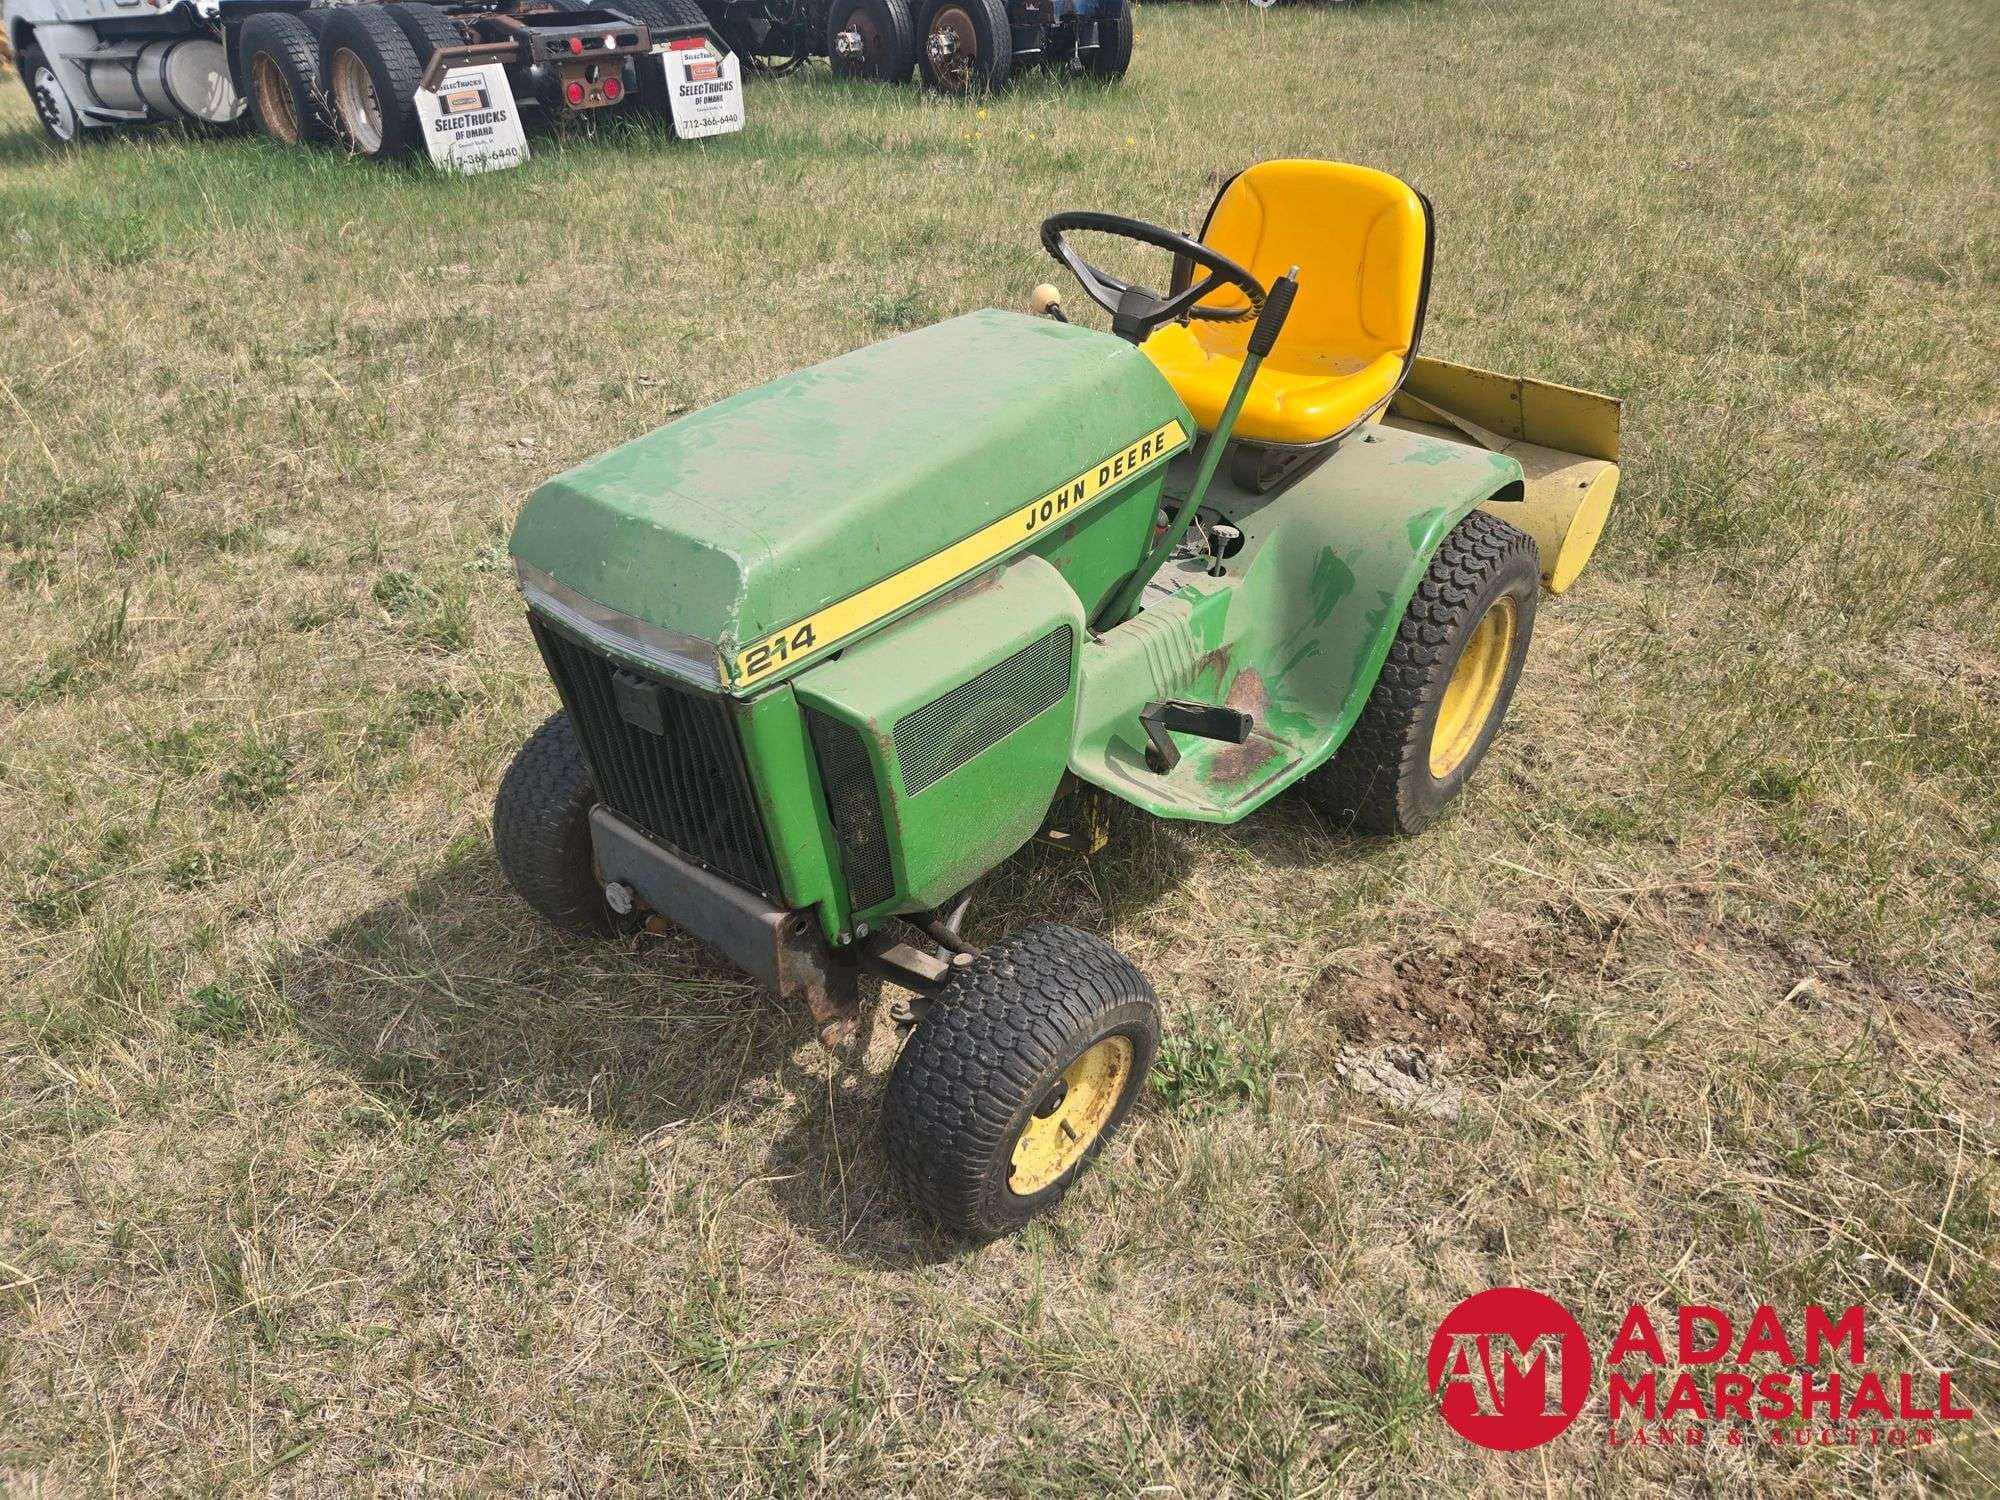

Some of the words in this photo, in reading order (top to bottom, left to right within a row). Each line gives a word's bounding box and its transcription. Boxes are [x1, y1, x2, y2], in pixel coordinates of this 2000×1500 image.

[679, 80, 734, 97] SELECTRUCKS
[695, 97, 703, 105] OF
[704, 95, 723, 104] OMAHA
[435, 110, 507, 132] SELECTRUCKS
[683, 114, 738, 128] 712-366-6440
[455, 131, 464, 140] OF
[466, 126, 494, 139] OMAHA
[1025, 479, 1085, 531] JOHN
[1098, 432, 1166, 488] DEERE
[745, 623, 817, 676] 214
